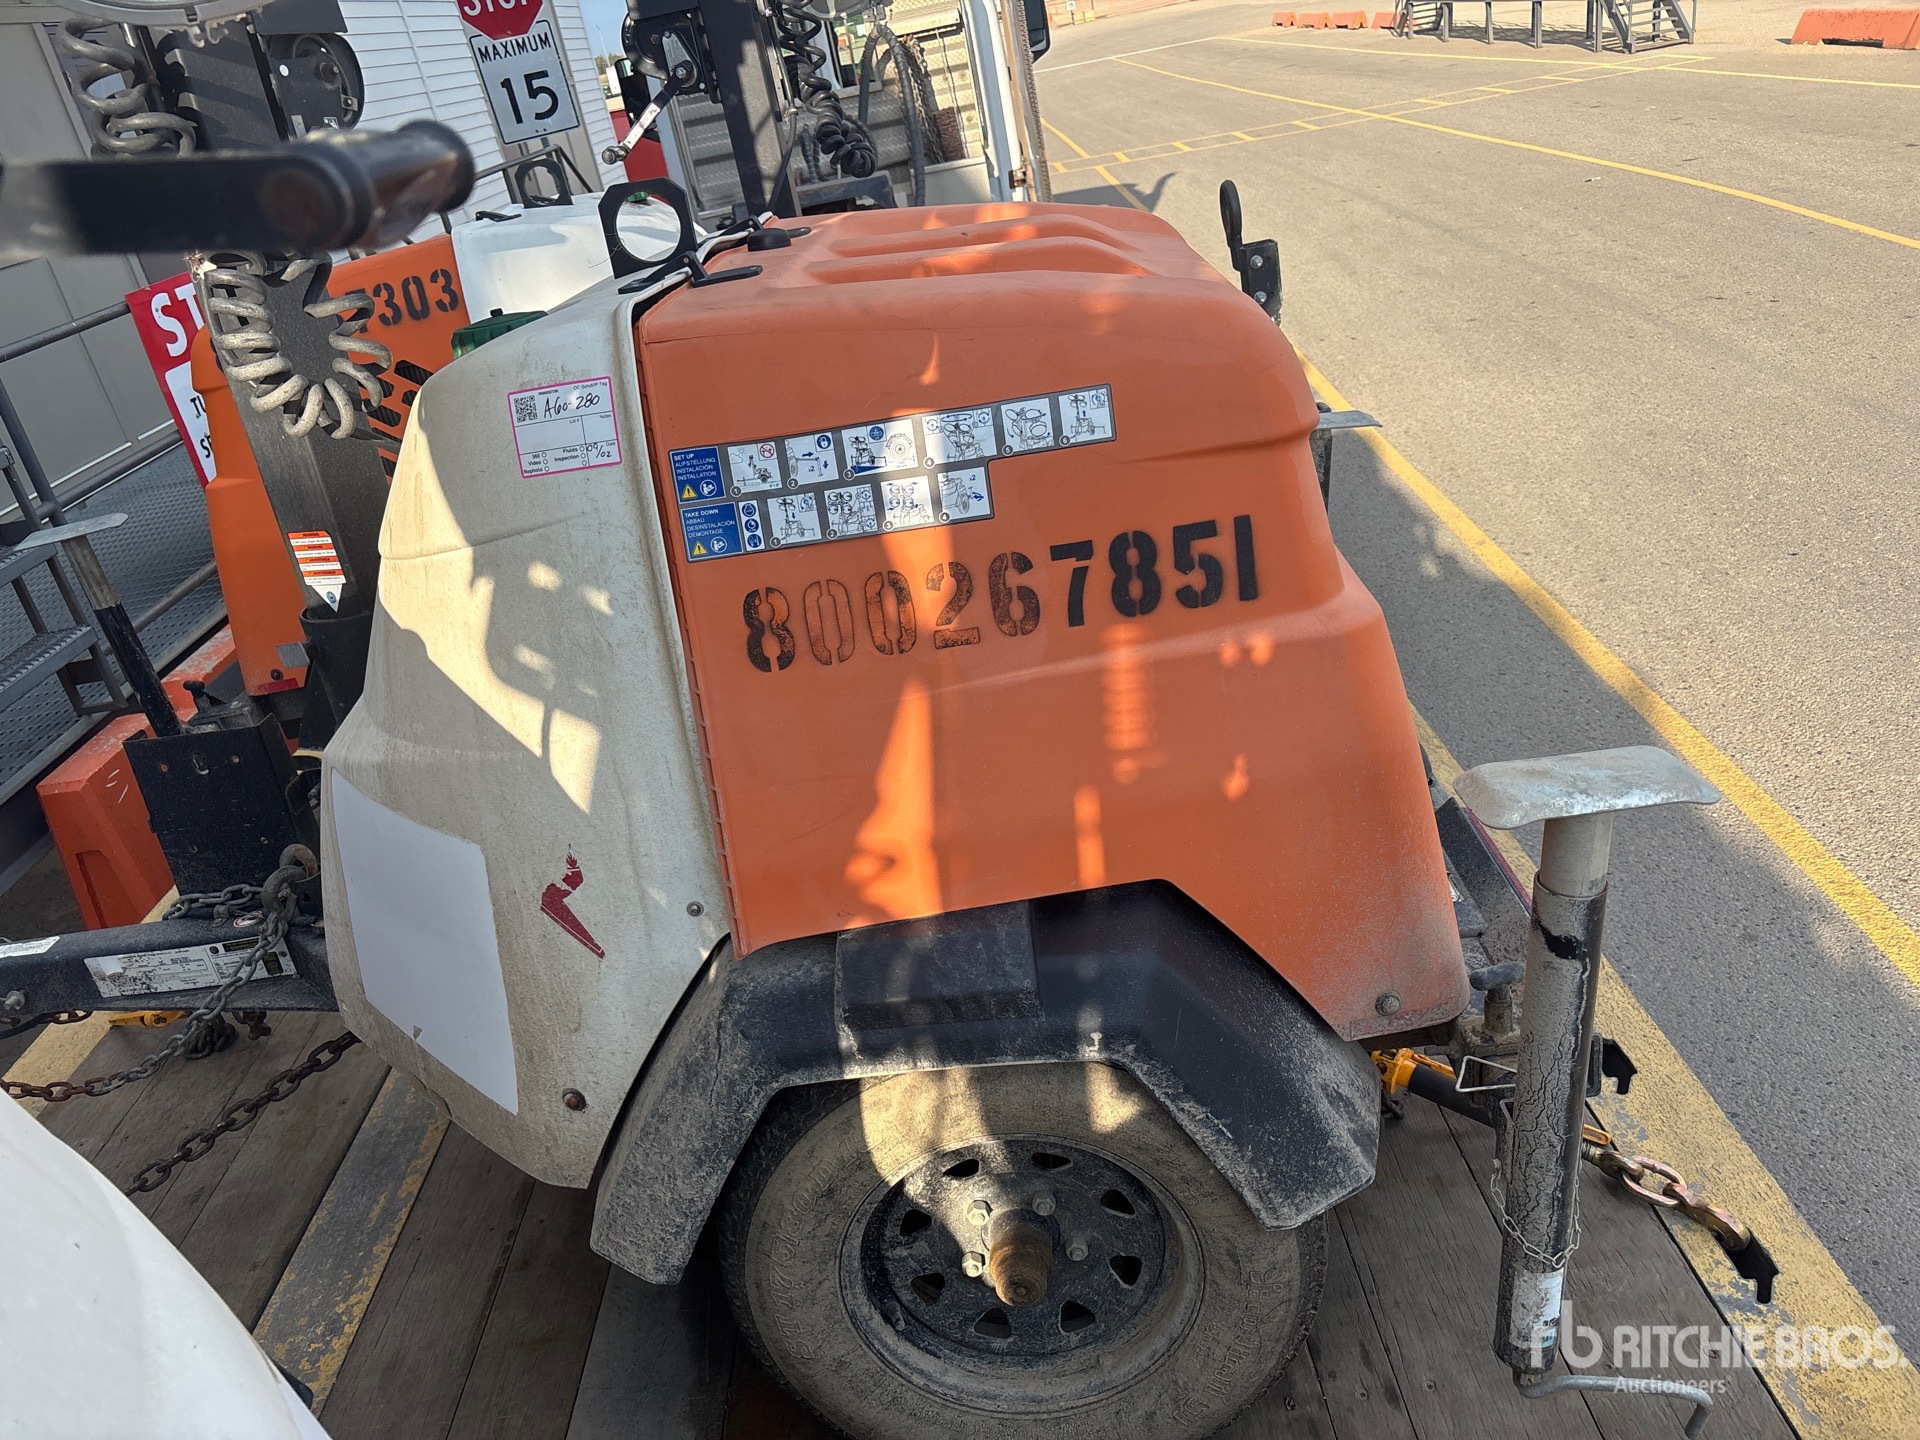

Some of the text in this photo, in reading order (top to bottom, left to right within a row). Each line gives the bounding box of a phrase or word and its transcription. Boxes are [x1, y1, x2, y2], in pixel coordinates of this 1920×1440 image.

[478, 32, 551, 63] MAXIMUM
[500, 70, 559, 124] 15
[345, 268, 459, 333] 303
[675, 457, 716, 467] AUFSTELLUNG
[677, 471, 717, 481] INSTALLATION
